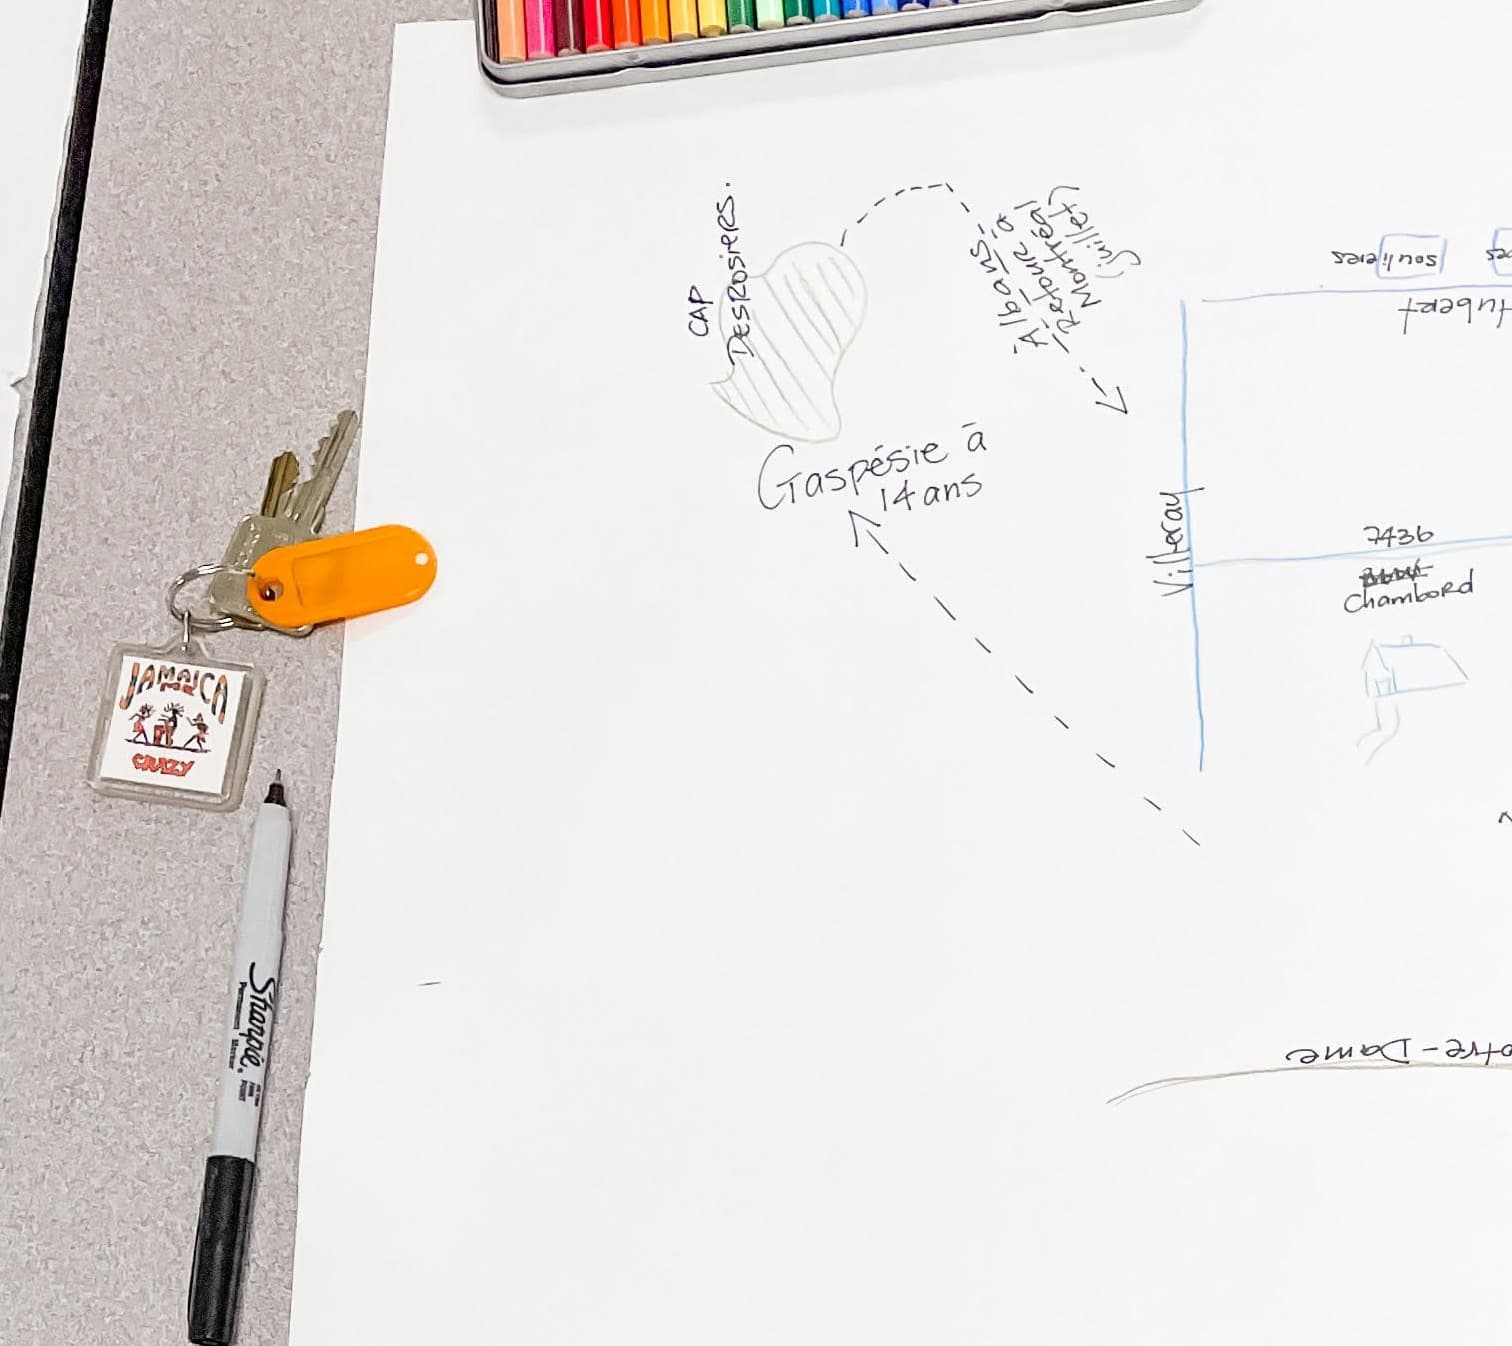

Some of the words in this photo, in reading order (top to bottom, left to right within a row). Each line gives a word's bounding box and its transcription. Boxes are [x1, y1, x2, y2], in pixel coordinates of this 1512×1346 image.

[1013, 240, 1080, 334] Retour
[1014, 200, 1102, 308] Montréal
[688, 284, 713, 336] CAP
[757, 442, 949, 511] Gaspésie
[1146, 486, 1204, 598] Villeray
[118, 662, 229, 725] JAMAICA
[132, 753, 196, 777] CRAZY
[239, 962, 276, 1068] Sharpie
